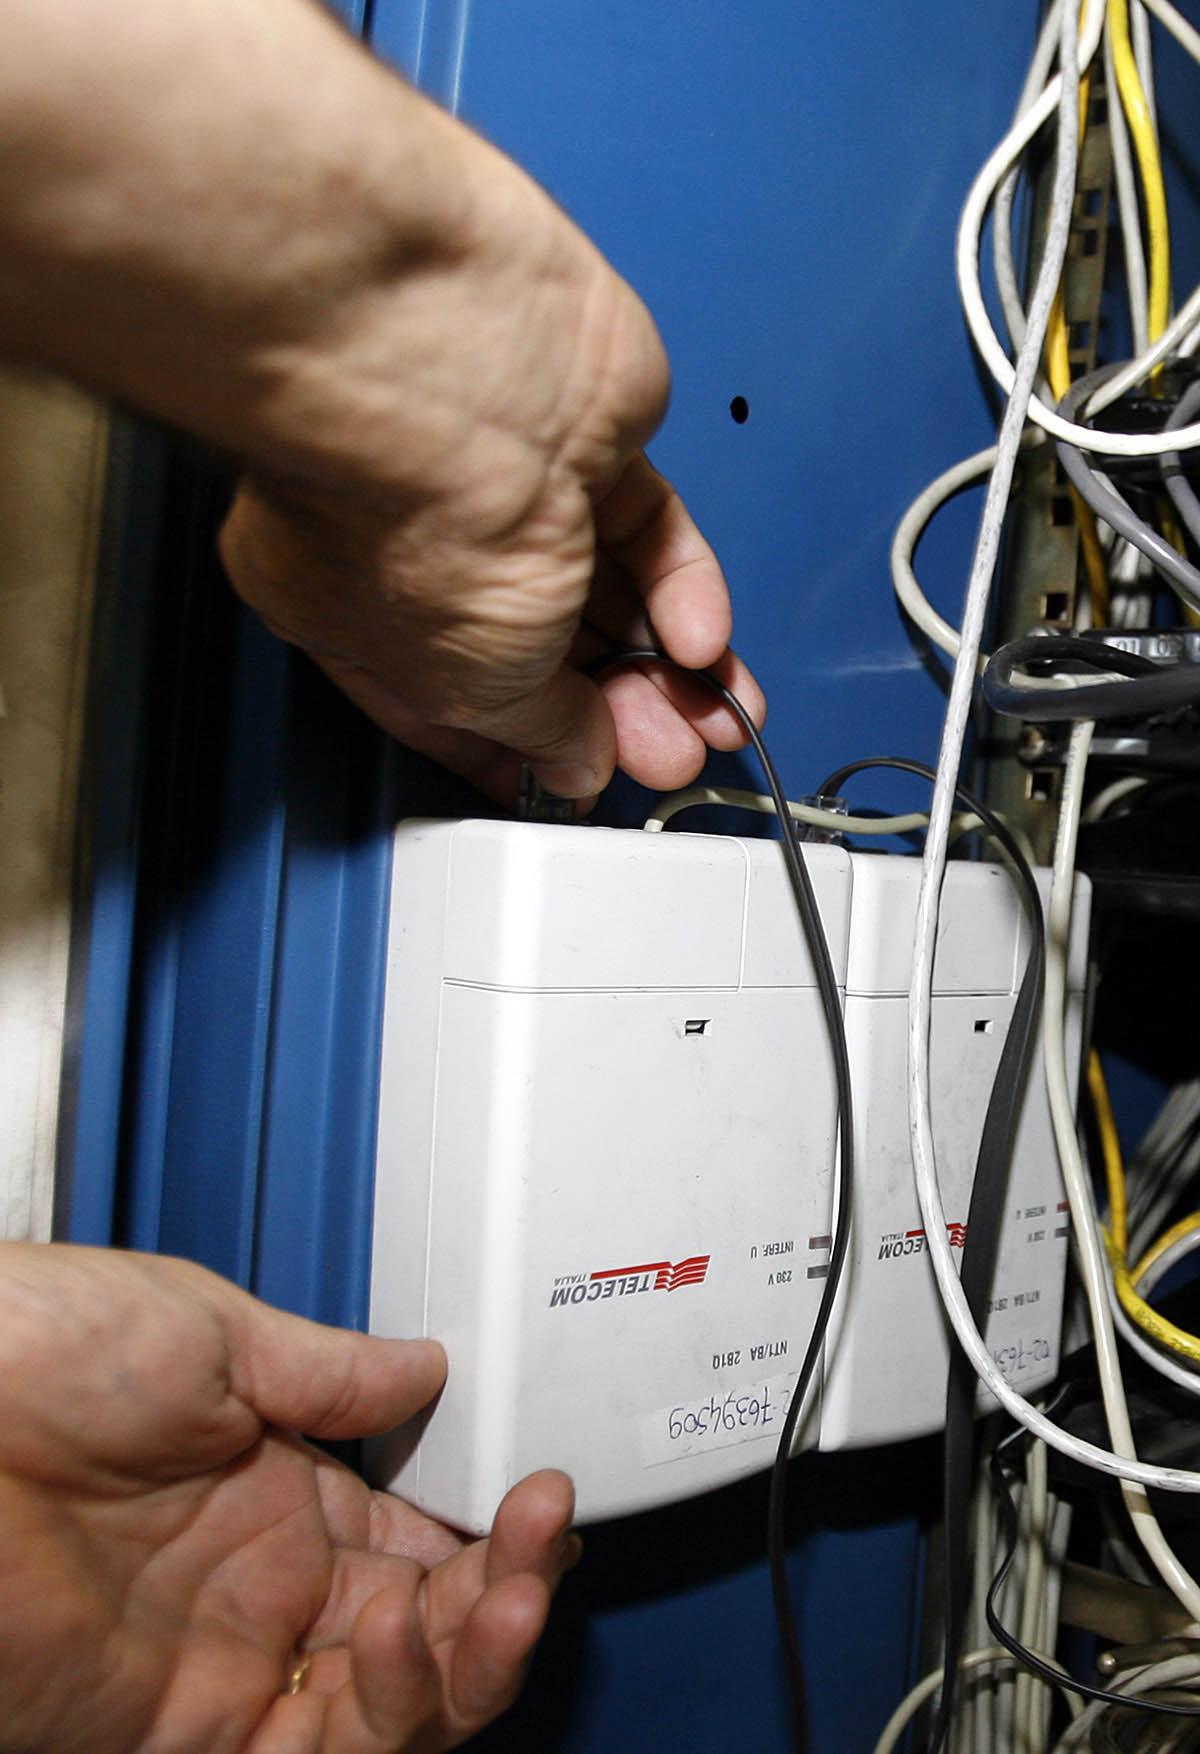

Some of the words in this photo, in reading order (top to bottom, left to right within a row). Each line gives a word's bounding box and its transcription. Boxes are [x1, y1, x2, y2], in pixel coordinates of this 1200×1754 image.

[881, 1232, 904, 1243] ITALIA
[750, 1246, 758, 1259] U
[763, 1240, 794, 1258] INTERF.
[878, 1238, 925, 1260] ECOM
[554, 1273, 587, 1287] ITALIA
[767, 1273, 775, 1286] V
[776, 1270, 793, 1284] 230
[550, 1274, 650, 1308] TELECOM
[750, 1340, 788, 1361] NT1/BA
[712, 1350, 741, 1370] 2B1Q
